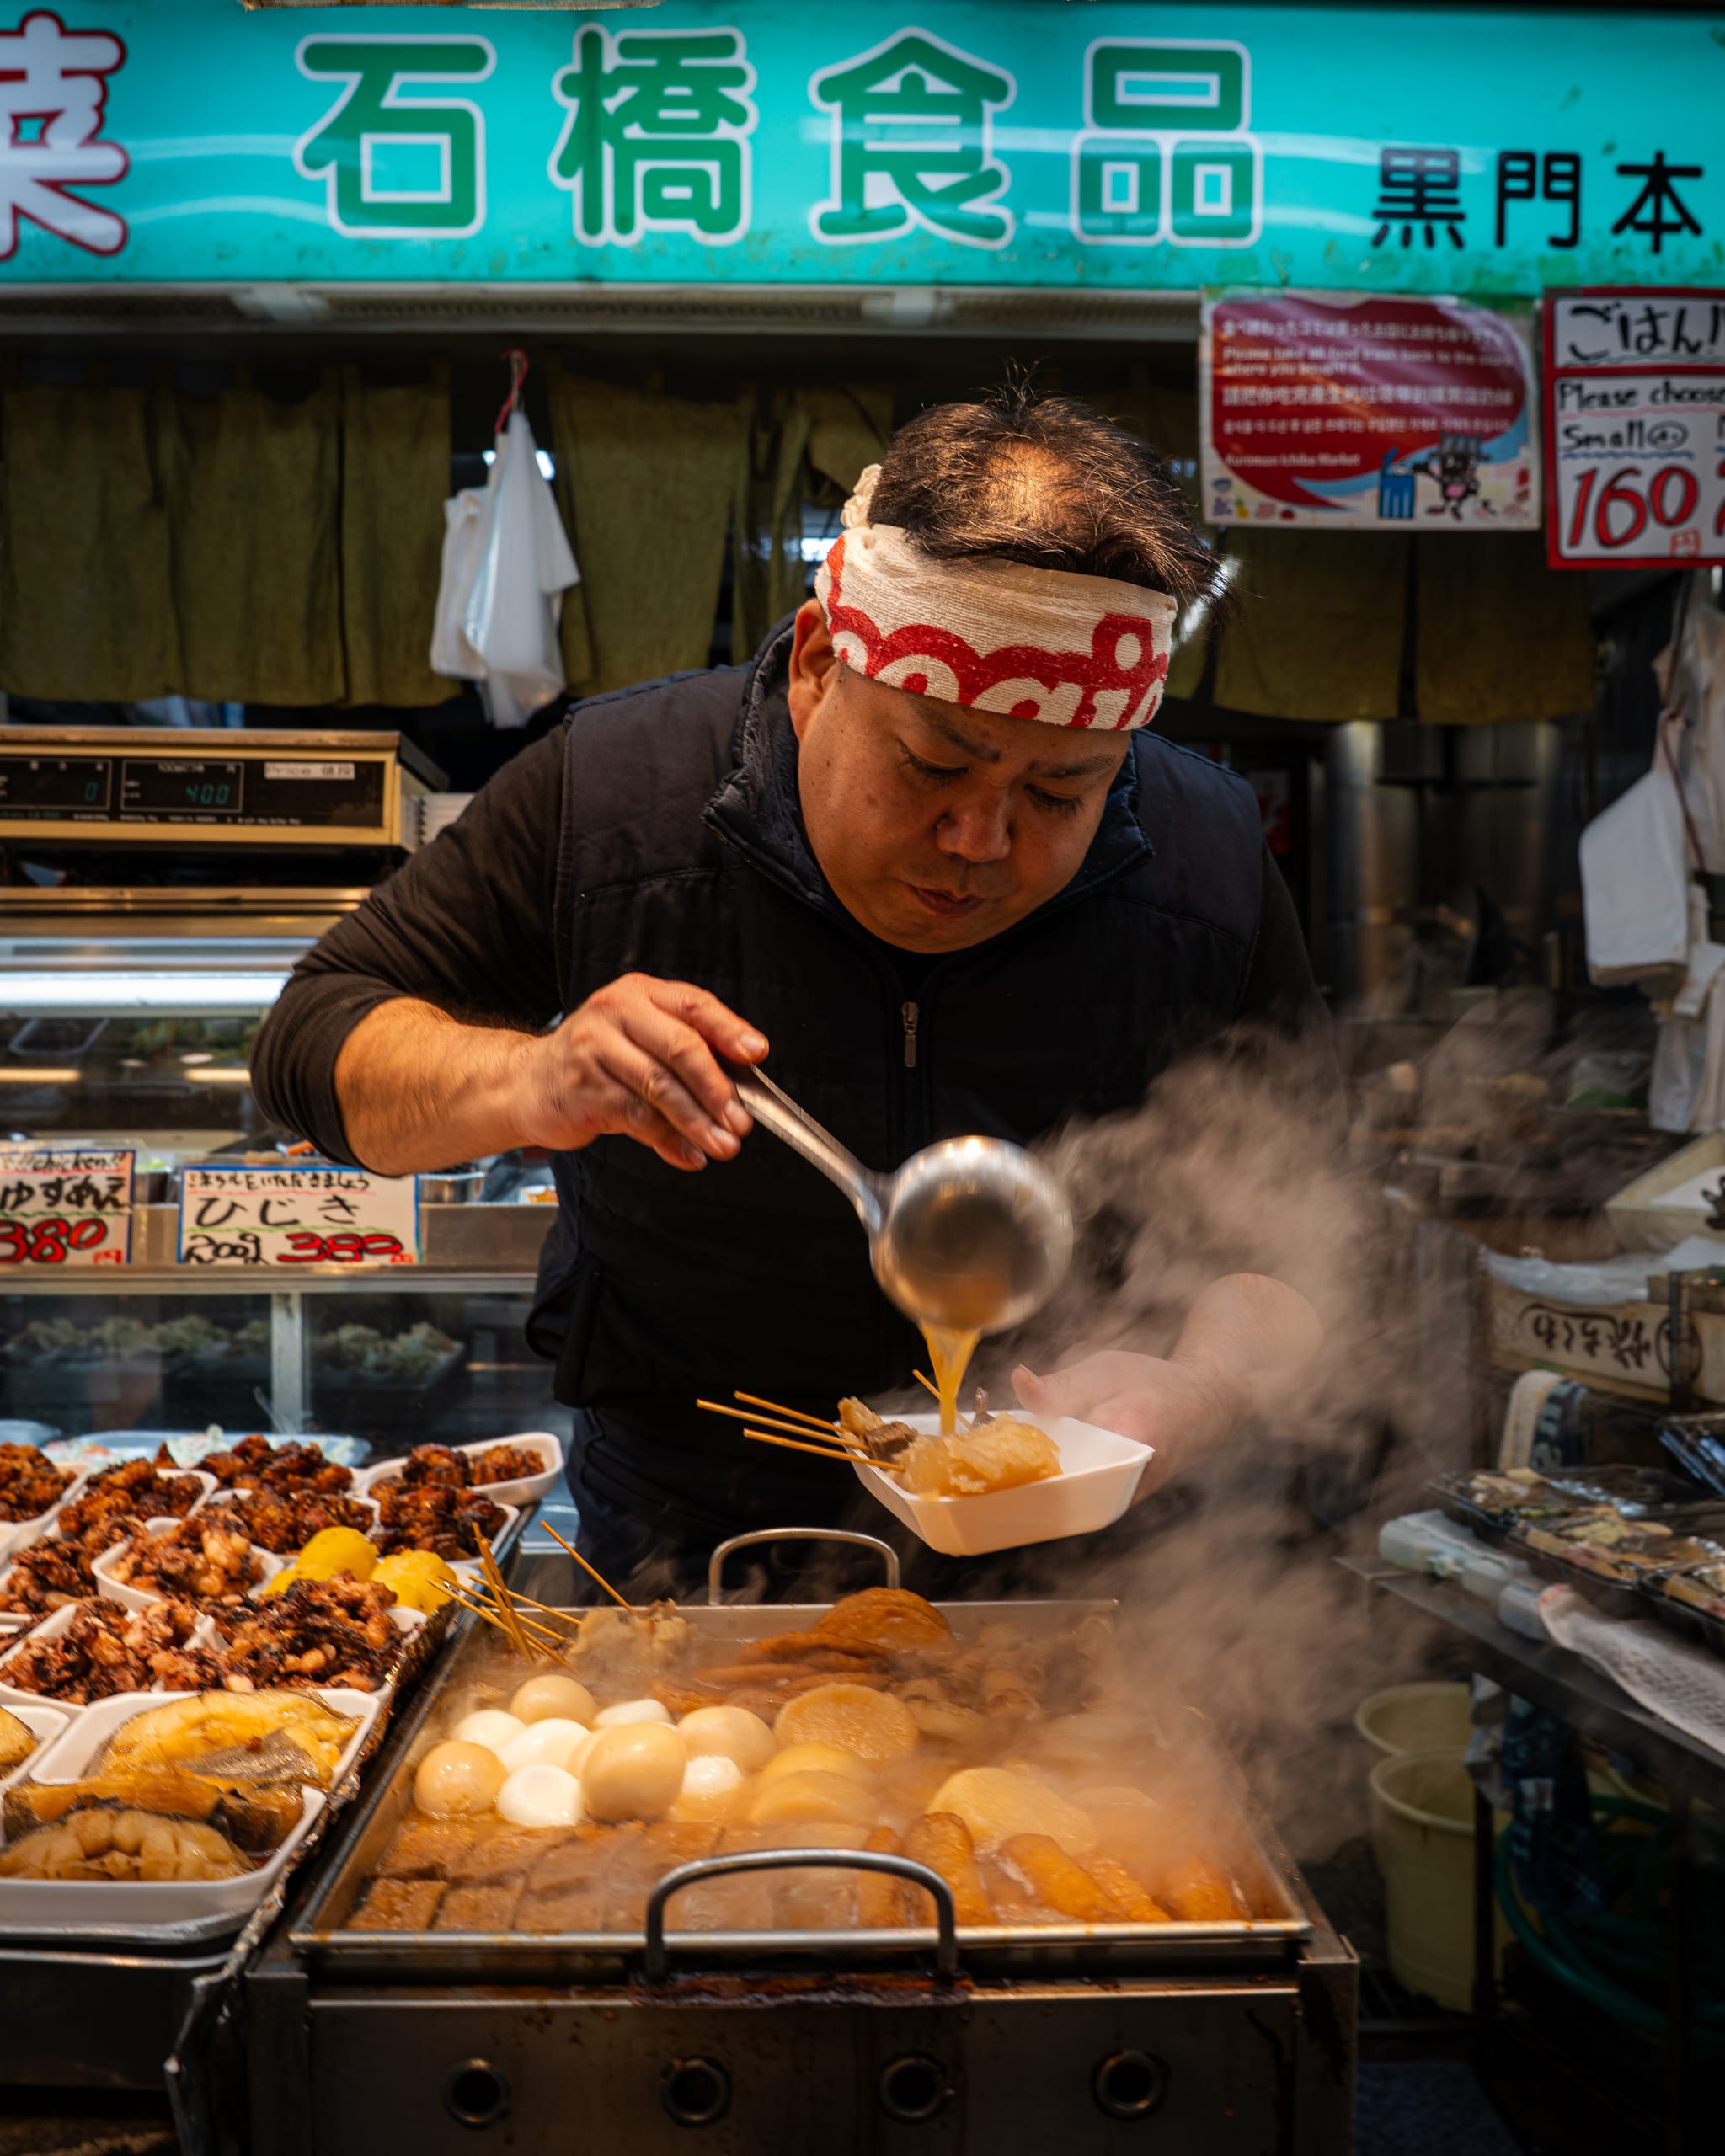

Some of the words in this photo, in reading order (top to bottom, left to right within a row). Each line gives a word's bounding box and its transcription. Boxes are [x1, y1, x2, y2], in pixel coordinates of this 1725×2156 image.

[292, 22, 1263, 249] 石橋食品
[1371, 148, 1703, 253] 黒門本
[1569, 302, 1725, 360] ごはん!
[1223, 345, 1272, 360] Please
[1435, 350, 1450, 364] to
[1453, 350, 1475, 365] the
[1269, 364, 1296, 377] you
[1560, 382, 1638, 410] Please
[1225, 453, 1278, 467] Kuromon
[1317, 453, 1361, 467] Market
[1567, 464, 1701, 548] 160
[85, 781, 99, 802] 0
[185, 783, 230, 805] 400
[195, 1194, 360, 1227] ひじき
[277, 1232, 403, 1262] 380
